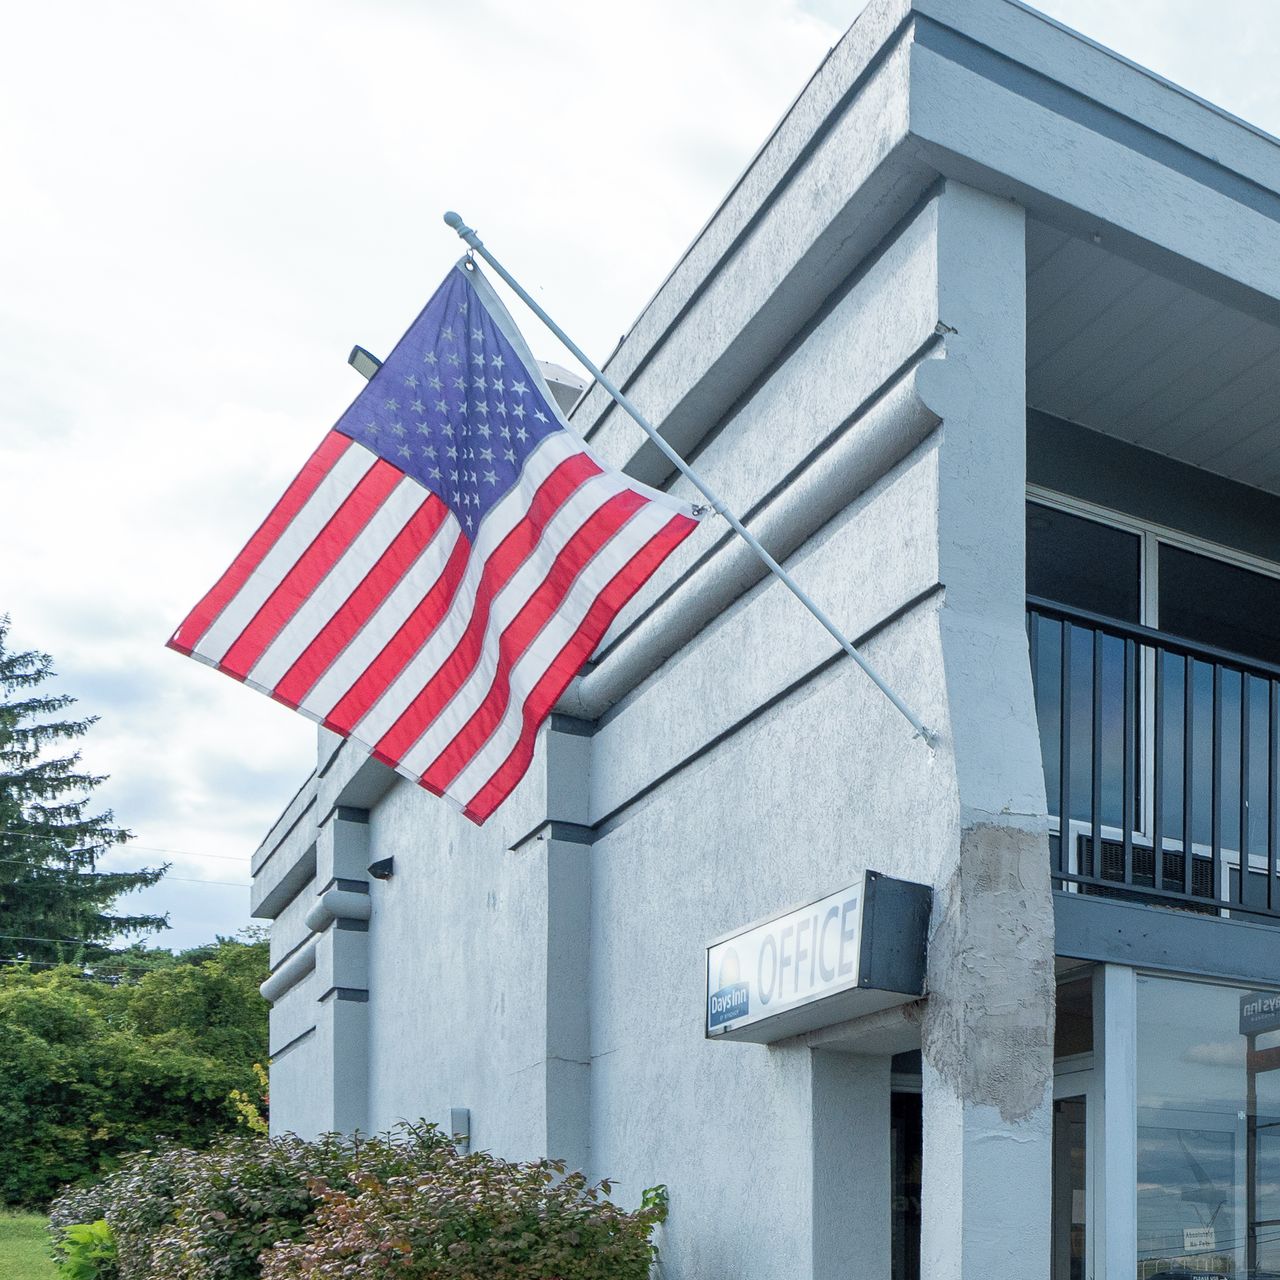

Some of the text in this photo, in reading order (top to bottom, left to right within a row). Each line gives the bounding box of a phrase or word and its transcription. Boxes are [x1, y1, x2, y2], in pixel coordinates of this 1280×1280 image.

[757, 897, 858, 1006] OFFICE
[711, 988, 747, 1014] Days Inn
